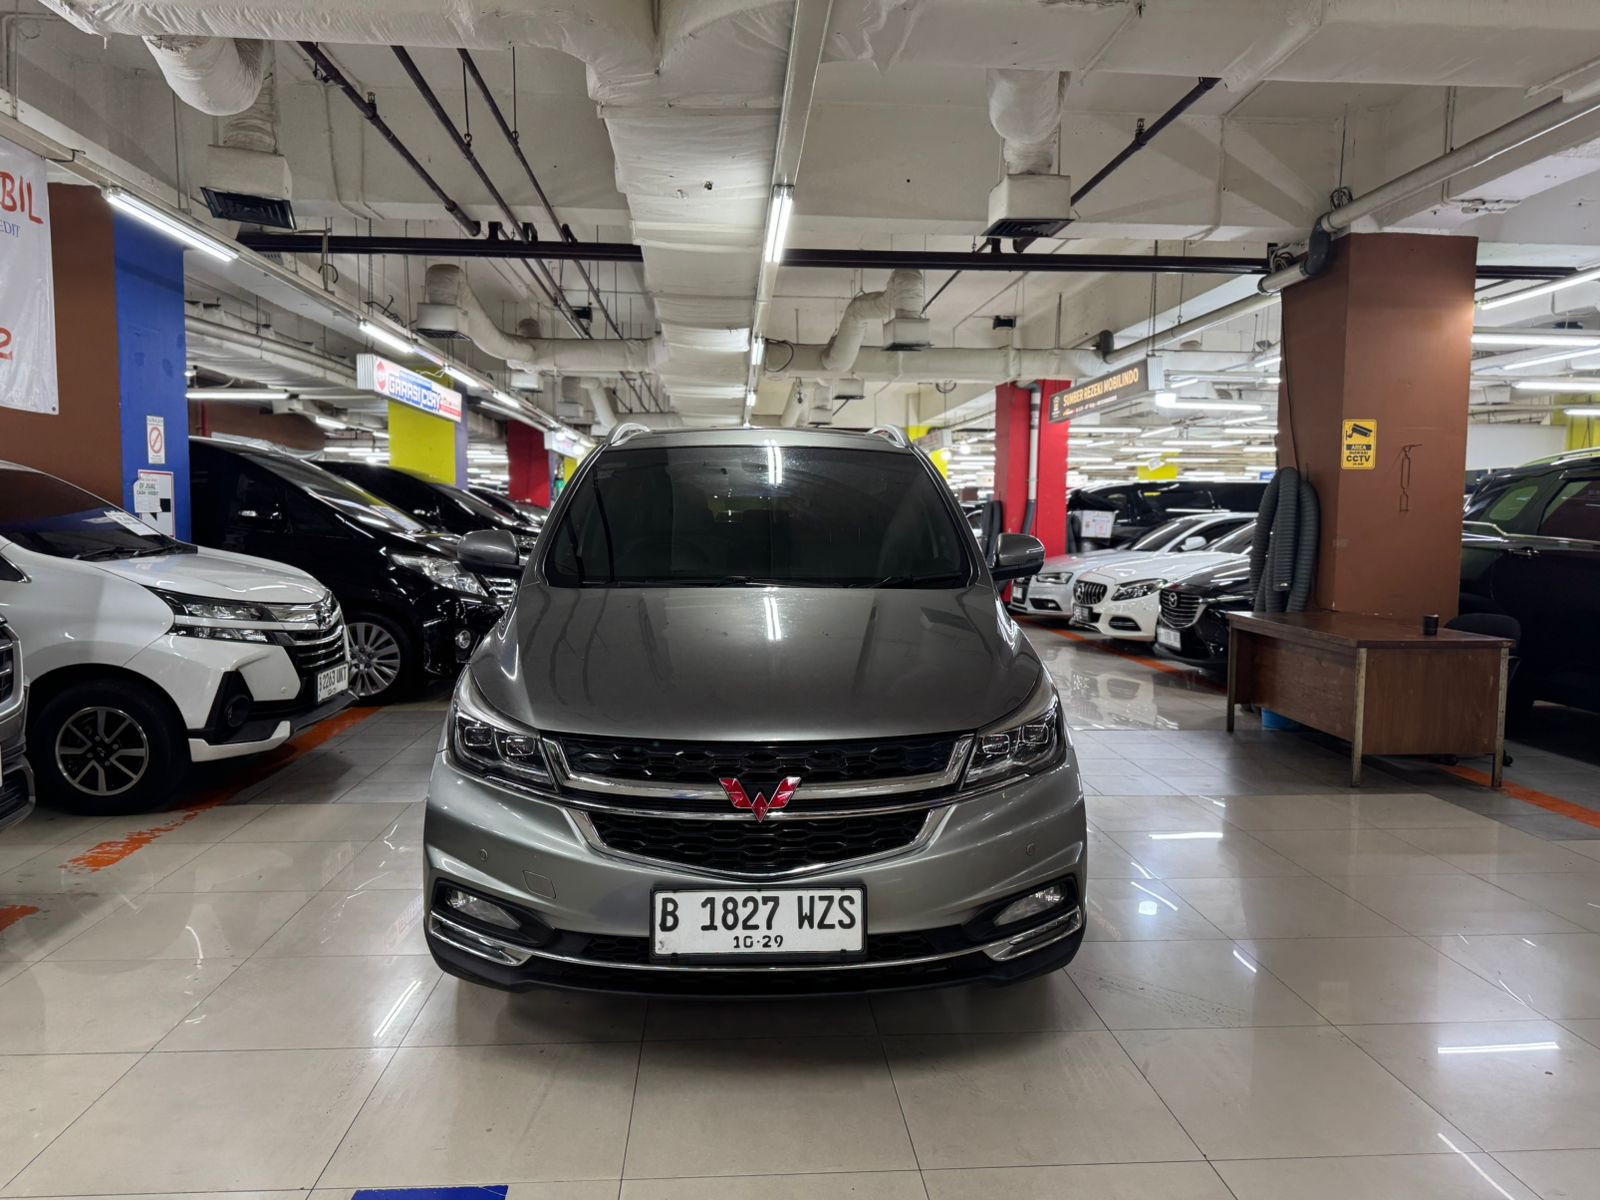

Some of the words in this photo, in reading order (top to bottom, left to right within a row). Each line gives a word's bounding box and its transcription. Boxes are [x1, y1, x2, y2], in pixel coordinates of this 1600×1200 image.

[388, 373, 420, 404] GARASI
[1063, 388, 1084, 406] SUMBER
[1084, 381, 1103, 400] REZEKI
[1104, 367, 1139, 393] MOBILINDO
[659, 897, 680, 932] B
[700, 896, 780, 931] 1827
[797, 895, 856, 930] WZS
